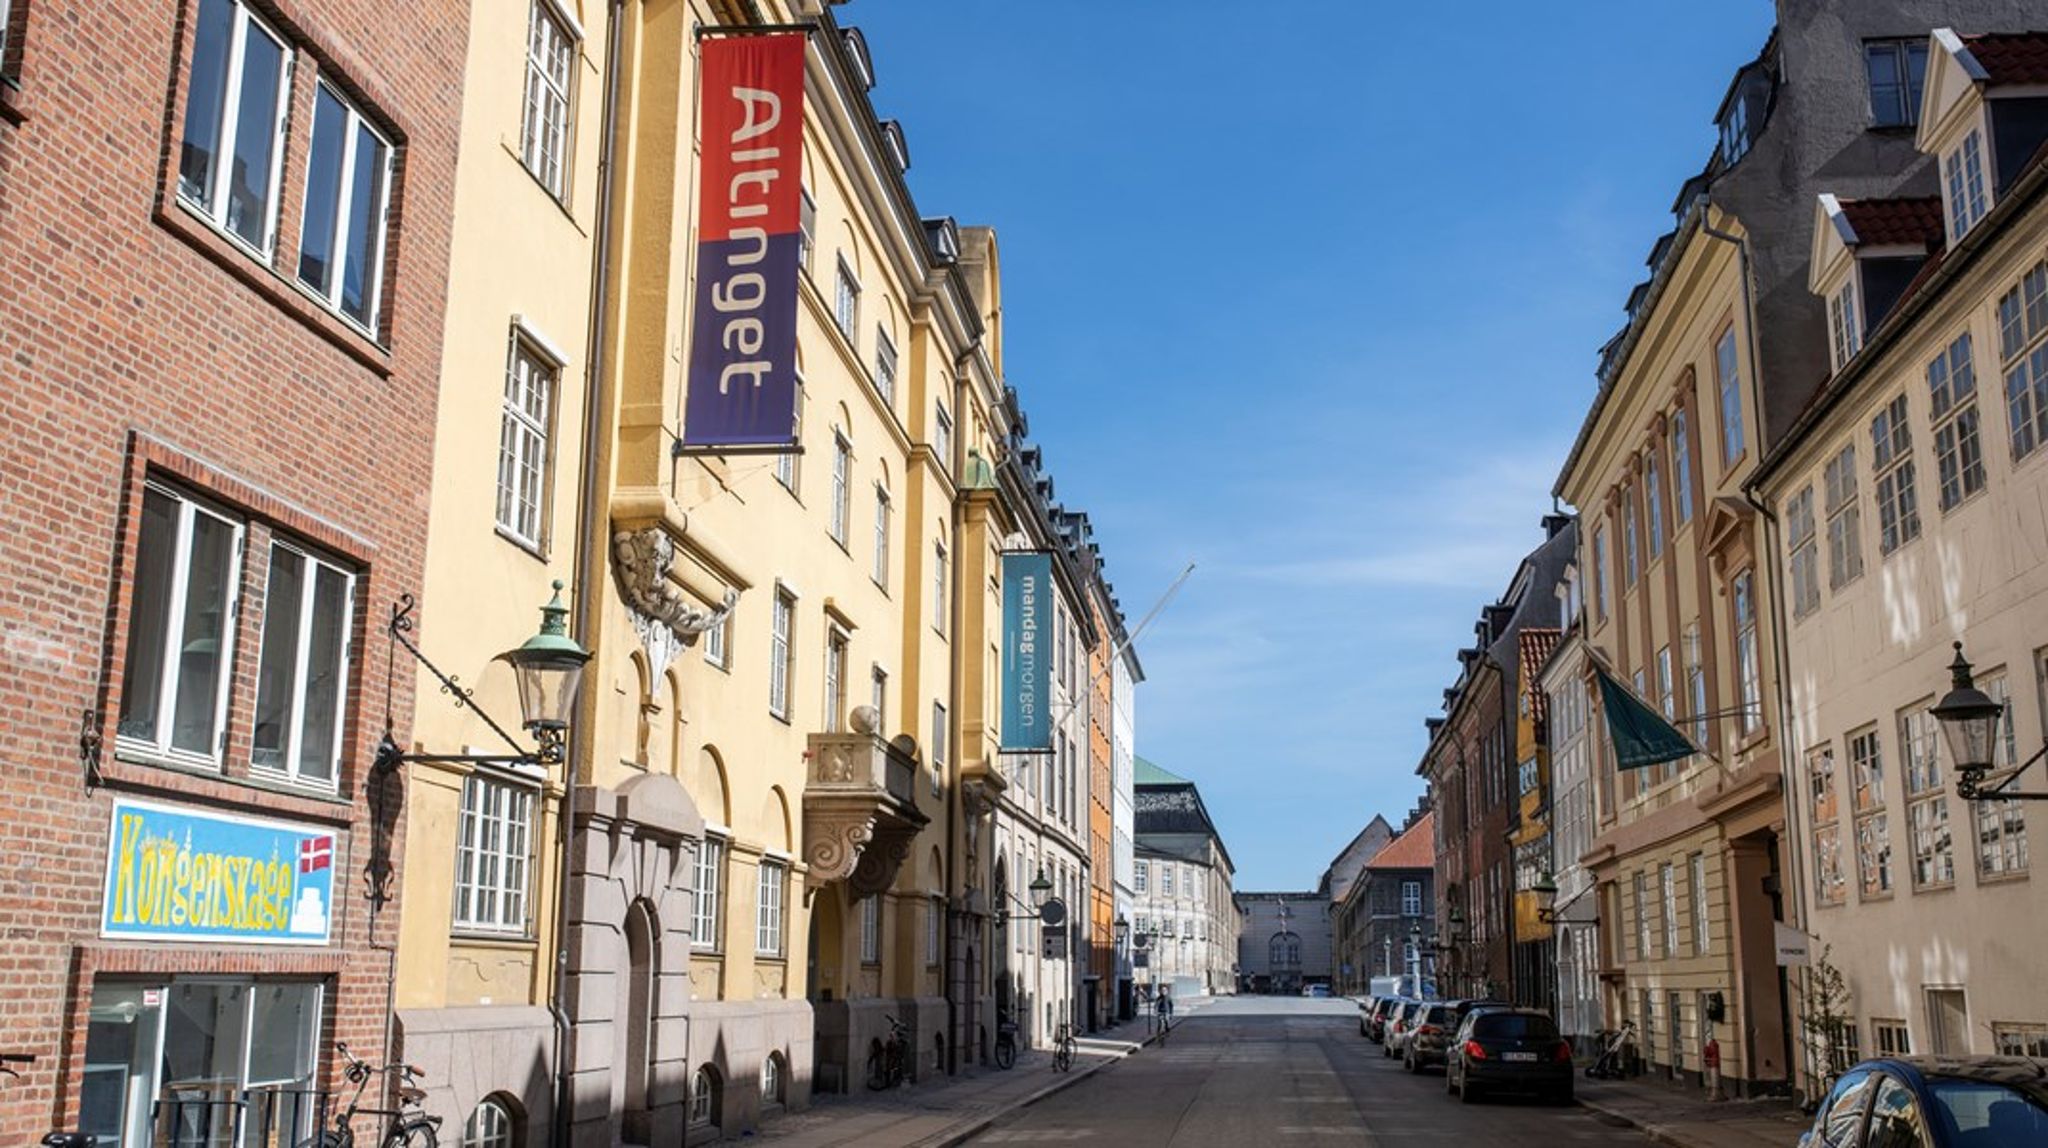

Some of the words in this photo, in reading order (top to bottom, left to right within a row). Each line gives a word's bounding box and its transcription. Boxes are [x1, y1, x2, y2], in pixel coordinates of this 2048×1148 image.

[712, 86, 781, 396] Altinget
[1020, 575, 1037, 727] mandagmorgen
[112, 813, 291, 931] Kongenskage
